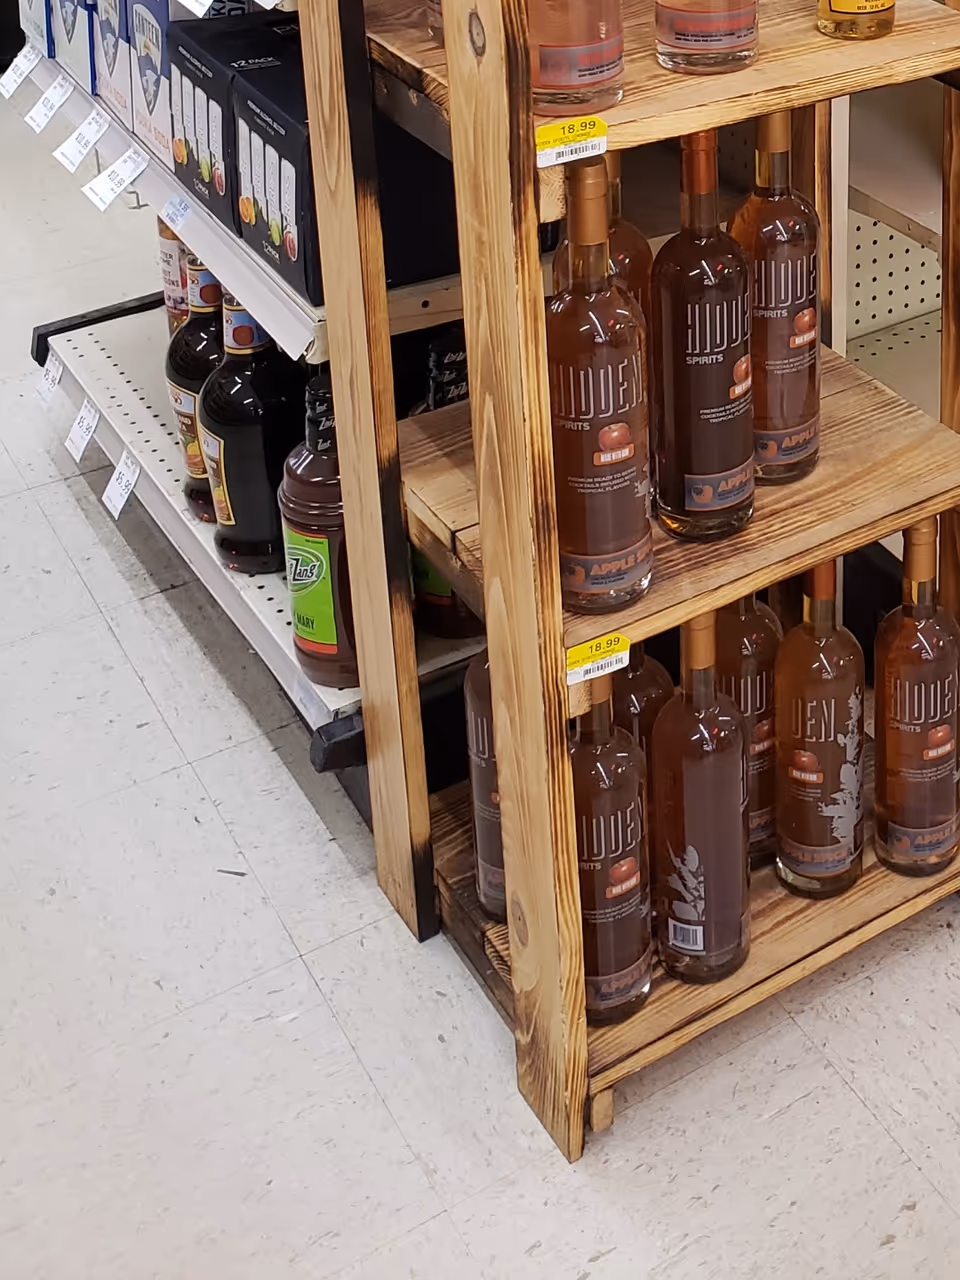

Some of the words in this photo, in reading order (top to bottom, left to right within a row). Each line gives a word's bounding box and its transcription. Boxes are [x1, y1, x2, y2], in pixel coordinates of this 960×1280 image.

[561, 120, 597, 135] 18.99
[686, 354, 724, 365] SPIRITS
[115, 471, 132, 495] $5.99
[590, 556, 637, 575] APPLE
[297, 615, 315, 629] MARY
[588, 636, 620, 654] 18.99
